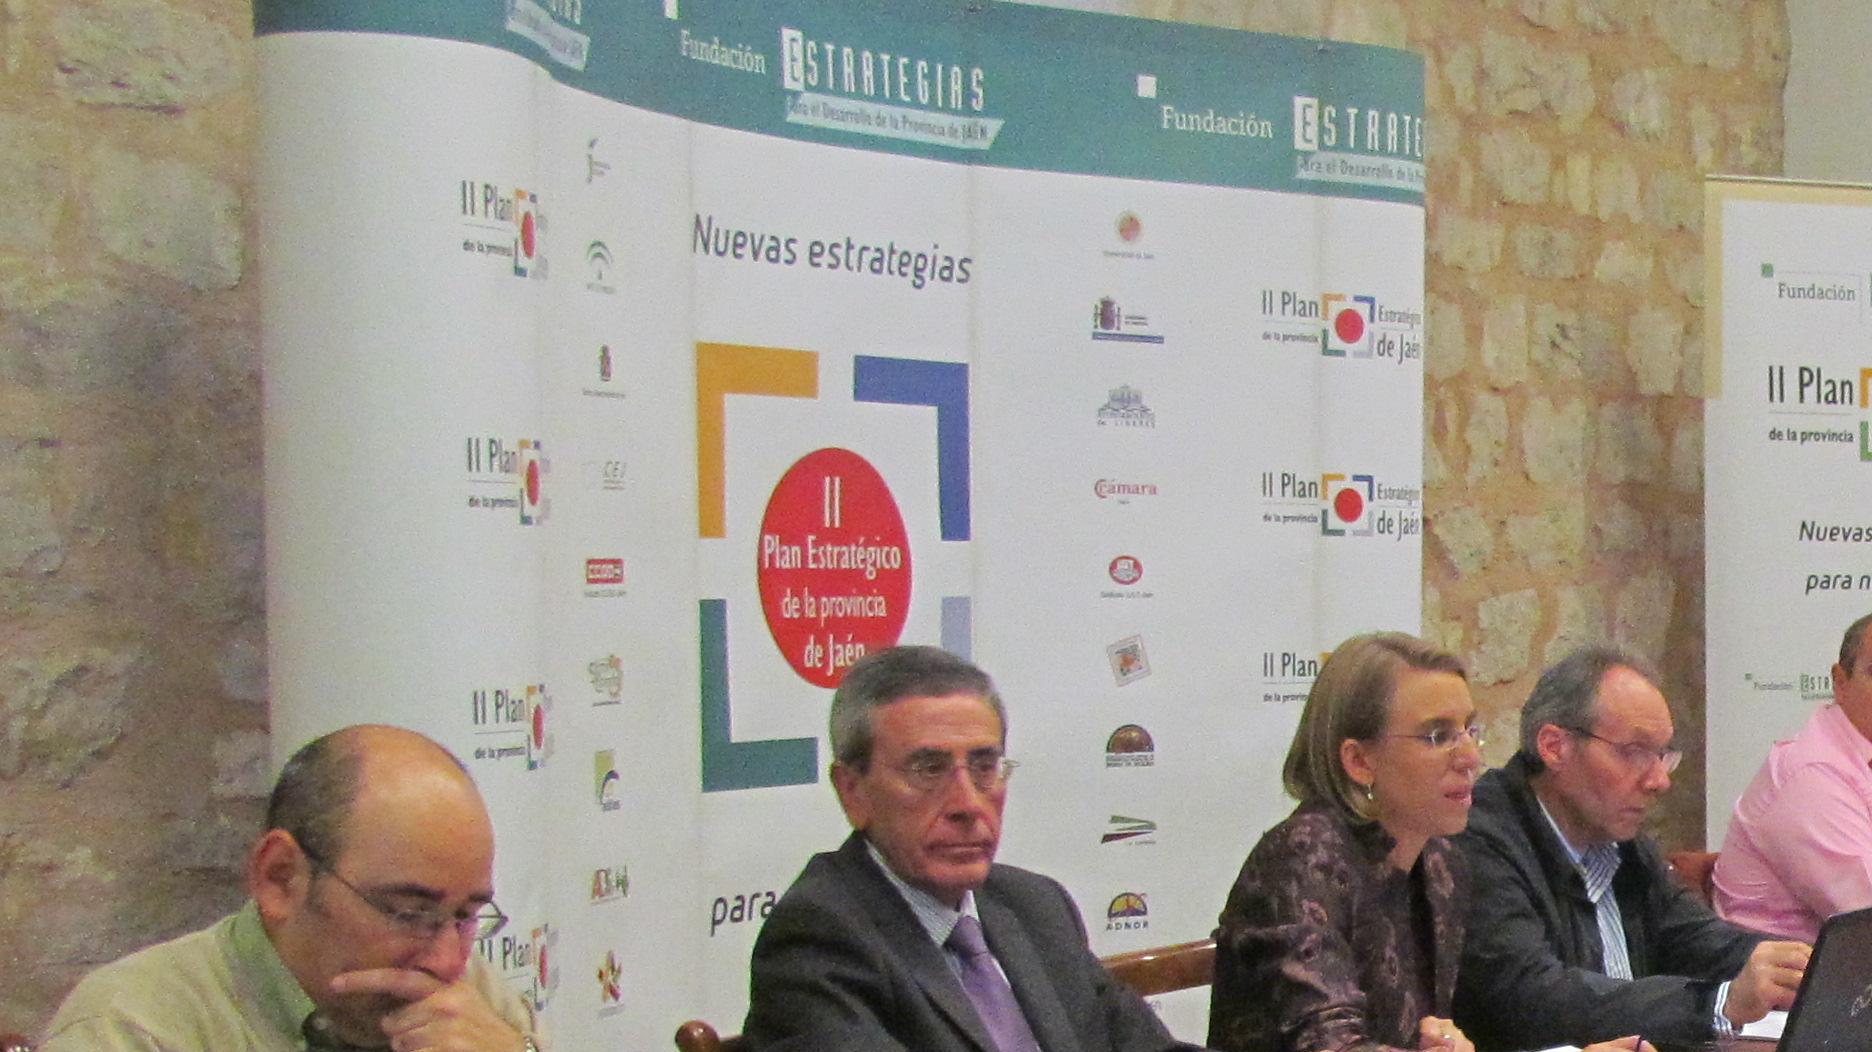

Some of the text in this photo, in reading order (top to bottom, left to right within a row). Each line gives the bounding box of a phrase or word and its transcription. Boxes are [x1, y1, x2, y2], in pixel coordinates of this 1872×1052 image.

[681, 28, 766, 75] Fundación
[786, 34, 986, 112] ESTRATEGIAS
[1161, 104, 1274, 140] Fundación
[1300, 101, 1424, 159] ESTRATE
[692, 213, 973, 291] Nuevas estrategias
[1263, 290, 1318, 318] II Plan
[1777, 282, 1856, 302] Fundación
[1377, 332, 1395, 358] de
[1768, 365, 1854, 406] II Plan
[1768, 428, 1854, 446] de la provincia
[824, 475, 841, 529] II
[1263, 472, 1318, 498] II Plan
[1377, 510, 1394, 535] de
[763, 535, 901, 580] Plan Estratégico
[1805, 573, 1854, 595] para
[782, 587, 887, 627] de la provincia
[804, 634, 866, 677] de Jaén
[1264, 652, 1317, 677] II Plan
[474, 690, 486, 725] II
[710, 891, 777, 938] para
